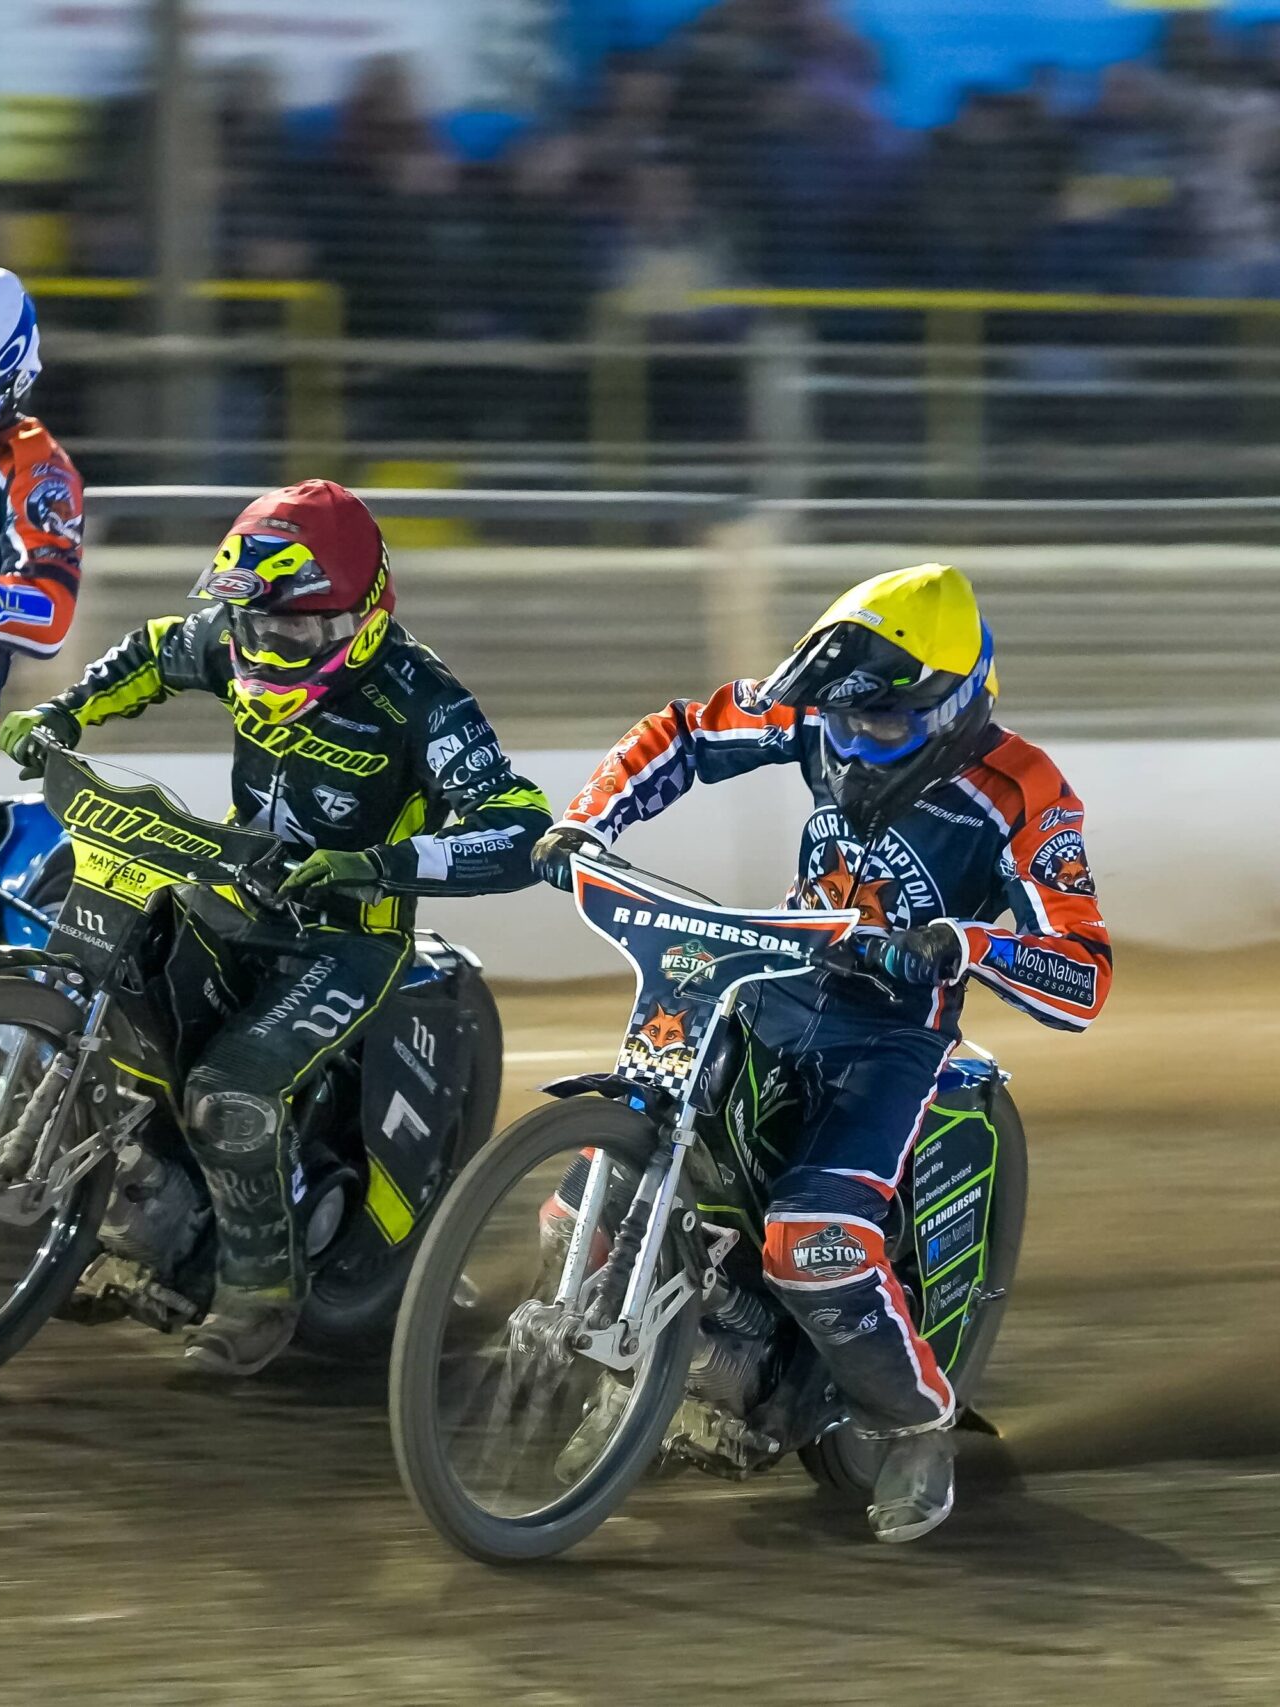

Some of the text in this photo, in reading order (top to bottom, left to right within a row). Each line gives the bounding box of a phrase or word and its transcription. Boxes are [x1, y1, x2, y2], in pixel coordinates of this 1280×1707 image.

[295, 736, 389, 777] group
[64, 789, 161, 843] tru7
[315, 789, 355, 819] 75
[89, 852, 147, 884] MAYFELD
[807, 813, 935, 908] NORTMPTON
[613, 906, 801, 956] R D ANDERSON
[1015, 944, 1046, 974] Moto
[1048, 957, 1092, 991] National
[935, 1186, 982, 1227] ANDERSON
[793, 1245, 867, 1269] WESTON
